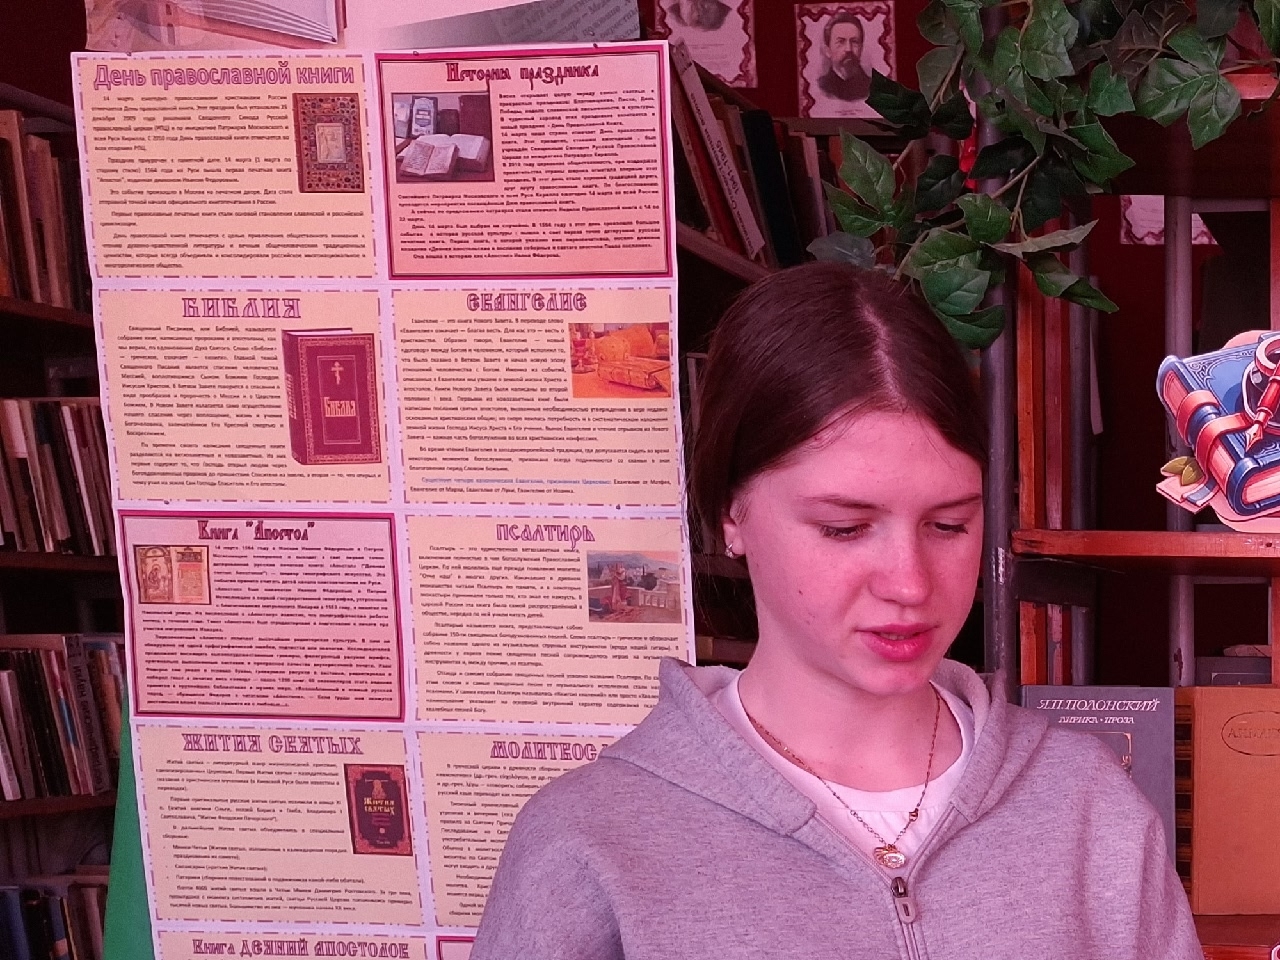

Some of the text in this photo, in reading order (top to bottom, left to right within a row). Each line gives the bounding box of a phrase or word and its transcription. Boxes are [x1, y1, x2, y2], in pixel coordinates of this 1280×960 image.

[93, 61, 354, 90] День православной книги
[182, 297, 301, 318] БИБЛИЯ
[467, 292, 587, 311] ЕВАНГЕЛИЕ
[496, 524, 595, 549] ПСАЛТИРЬ
[182, 733, 364, 755] ЖИТИЯ СВЯТЫХ
[239, 938, 308, 957] ДЕЯНИЙ
[314, 941, 409, 959] АПОСТОЛОВ
